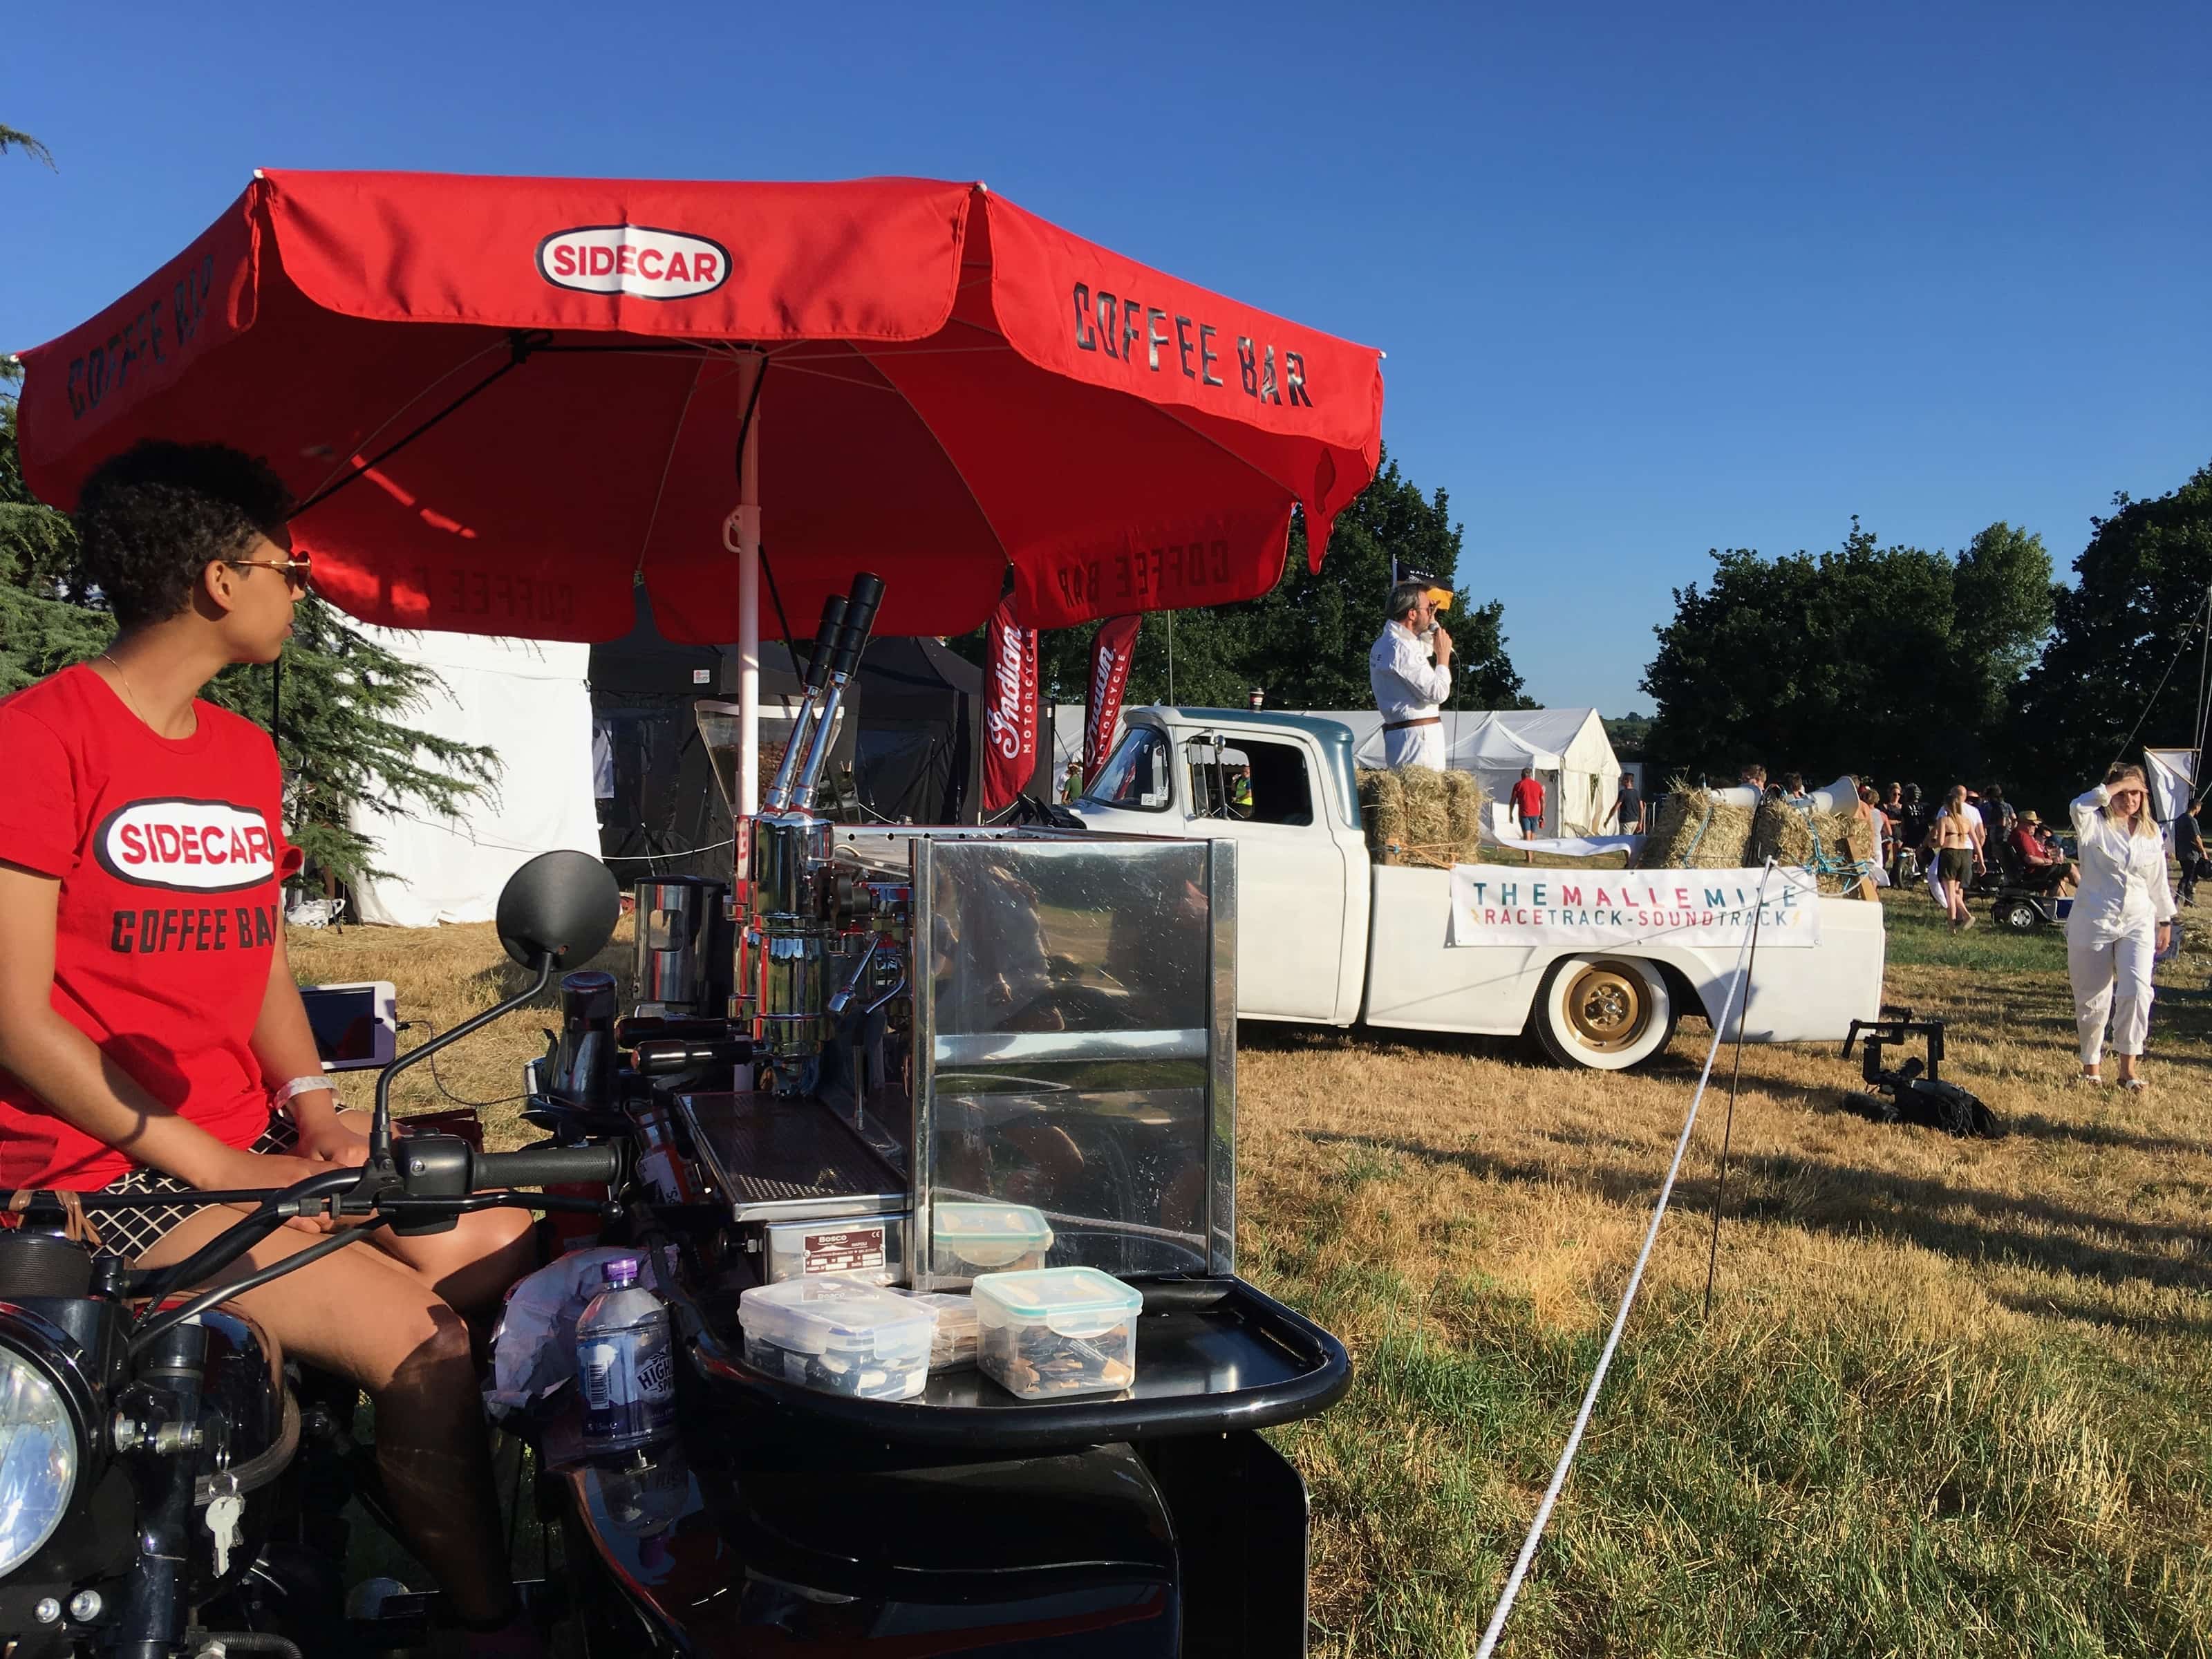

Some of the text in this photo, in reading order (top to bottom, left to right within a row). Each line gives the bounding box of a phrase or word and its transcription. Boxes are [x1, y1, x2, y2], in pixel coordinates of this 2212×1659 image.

[554, 245, 717, 282] SIDECAR
[1073, 281, 1313, 408] COFFEE BAR
[986, 625, 1022, 759] Indian
[1022, 630, 1034, 754] MOTORCYCLE
[1096, 654, 1126, 765] MOTORCYCLE
[120, 823, 273, 865] SIDECAR
[111, 905, 277, 954] COFFEE BA
[1473, 883, 1547, 906] THE
[1562, 885, 1691, 909] MALLE
